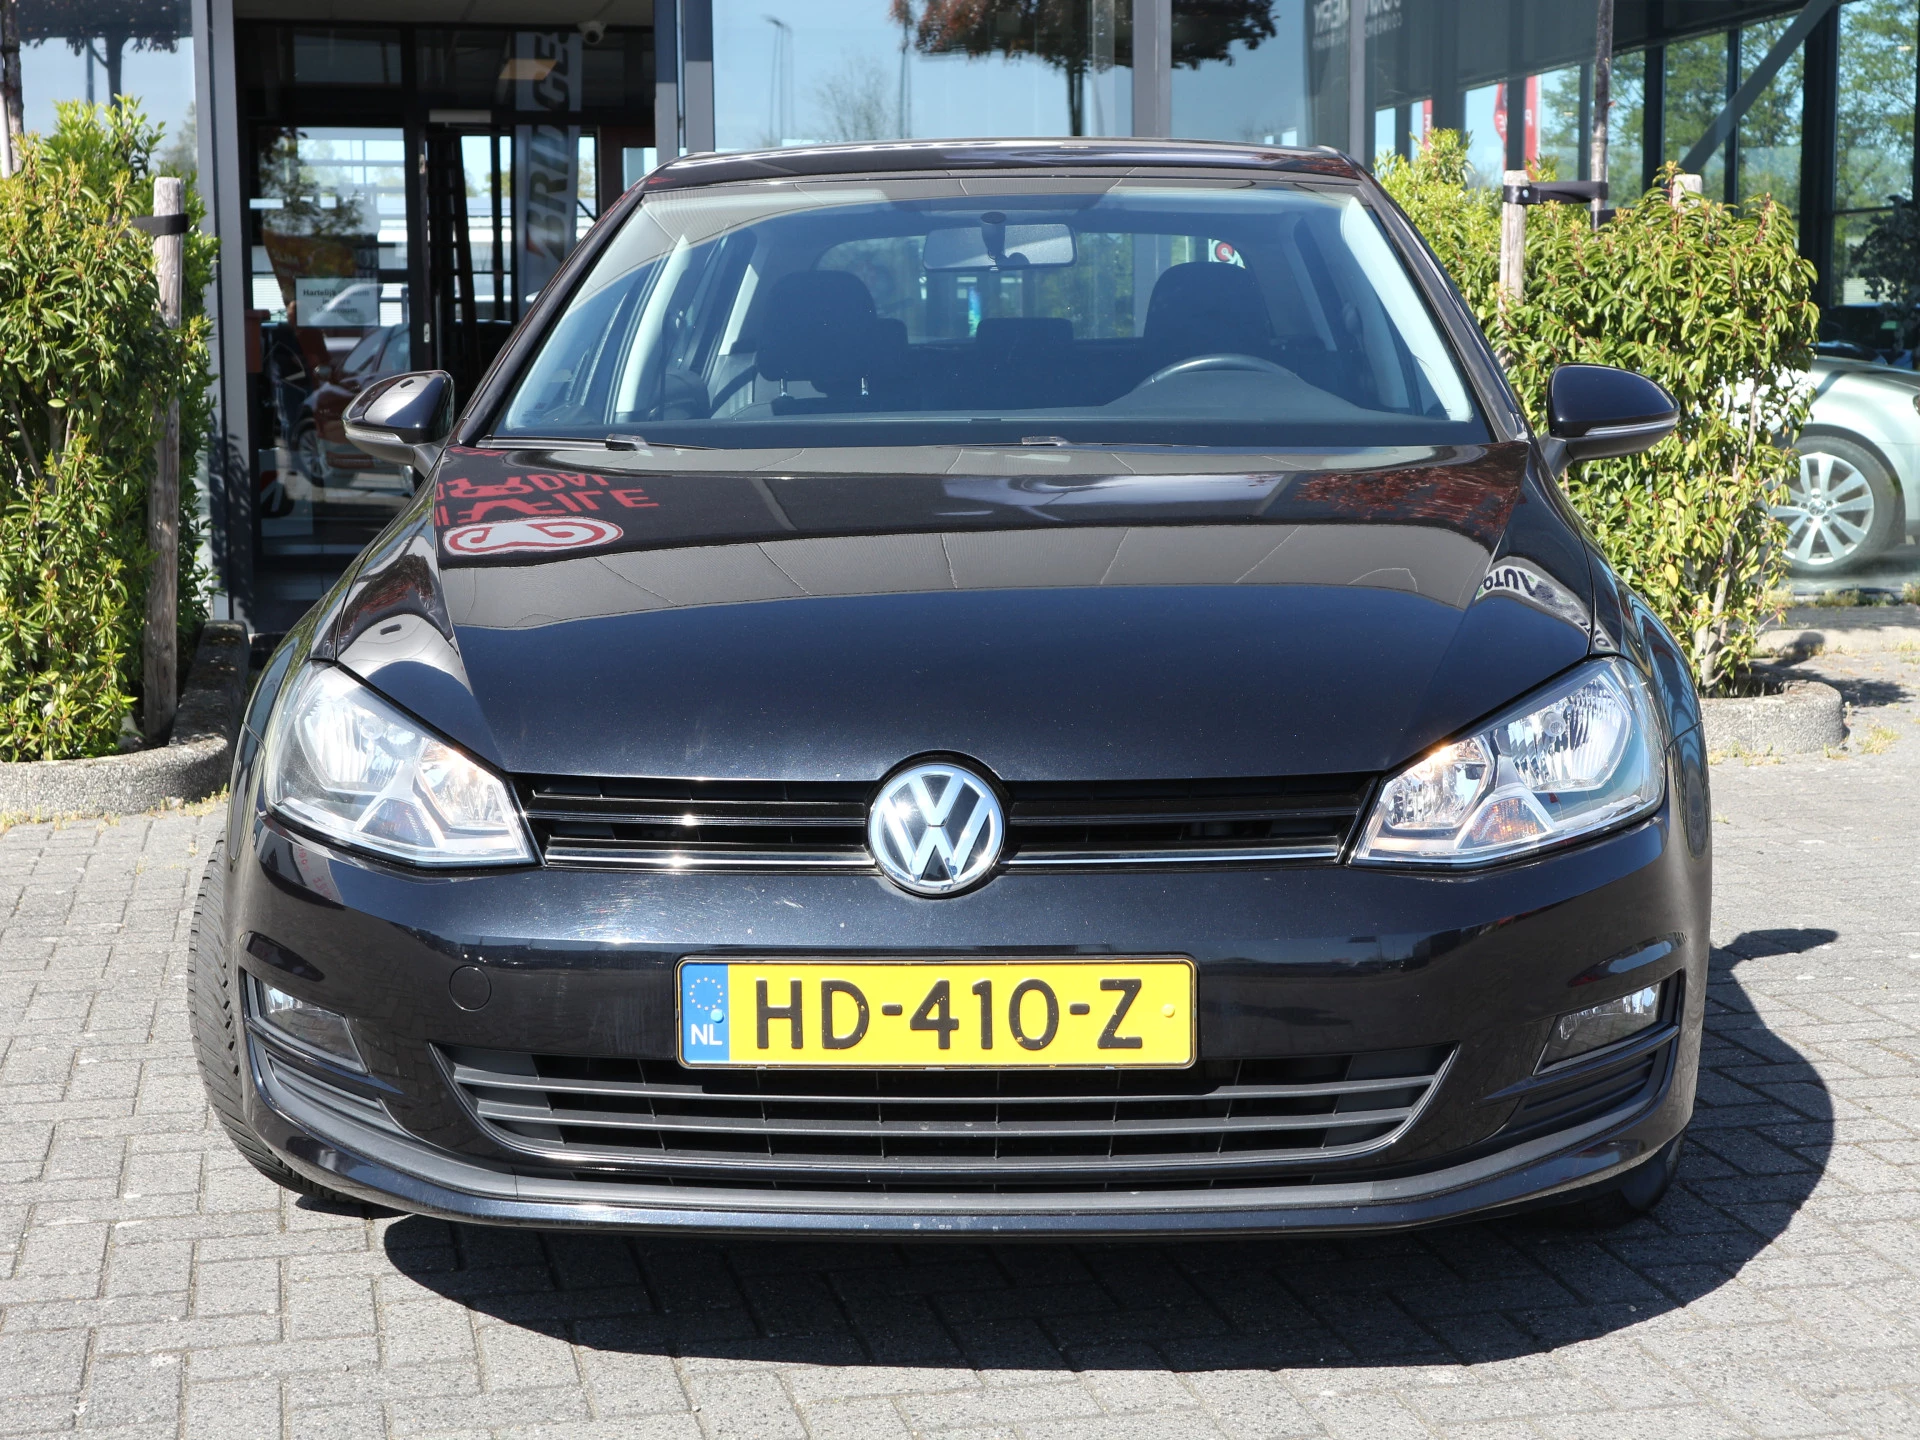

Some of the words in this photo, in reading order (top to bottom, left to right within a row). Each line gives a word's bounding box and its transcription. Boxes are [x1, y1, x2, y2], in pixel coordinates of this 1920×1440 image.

[527, 32, 569, 263] BRIDGE
[690, 1024, 723, 1046] NL
[755, 978, 1143, 1050] HD-410-Z
